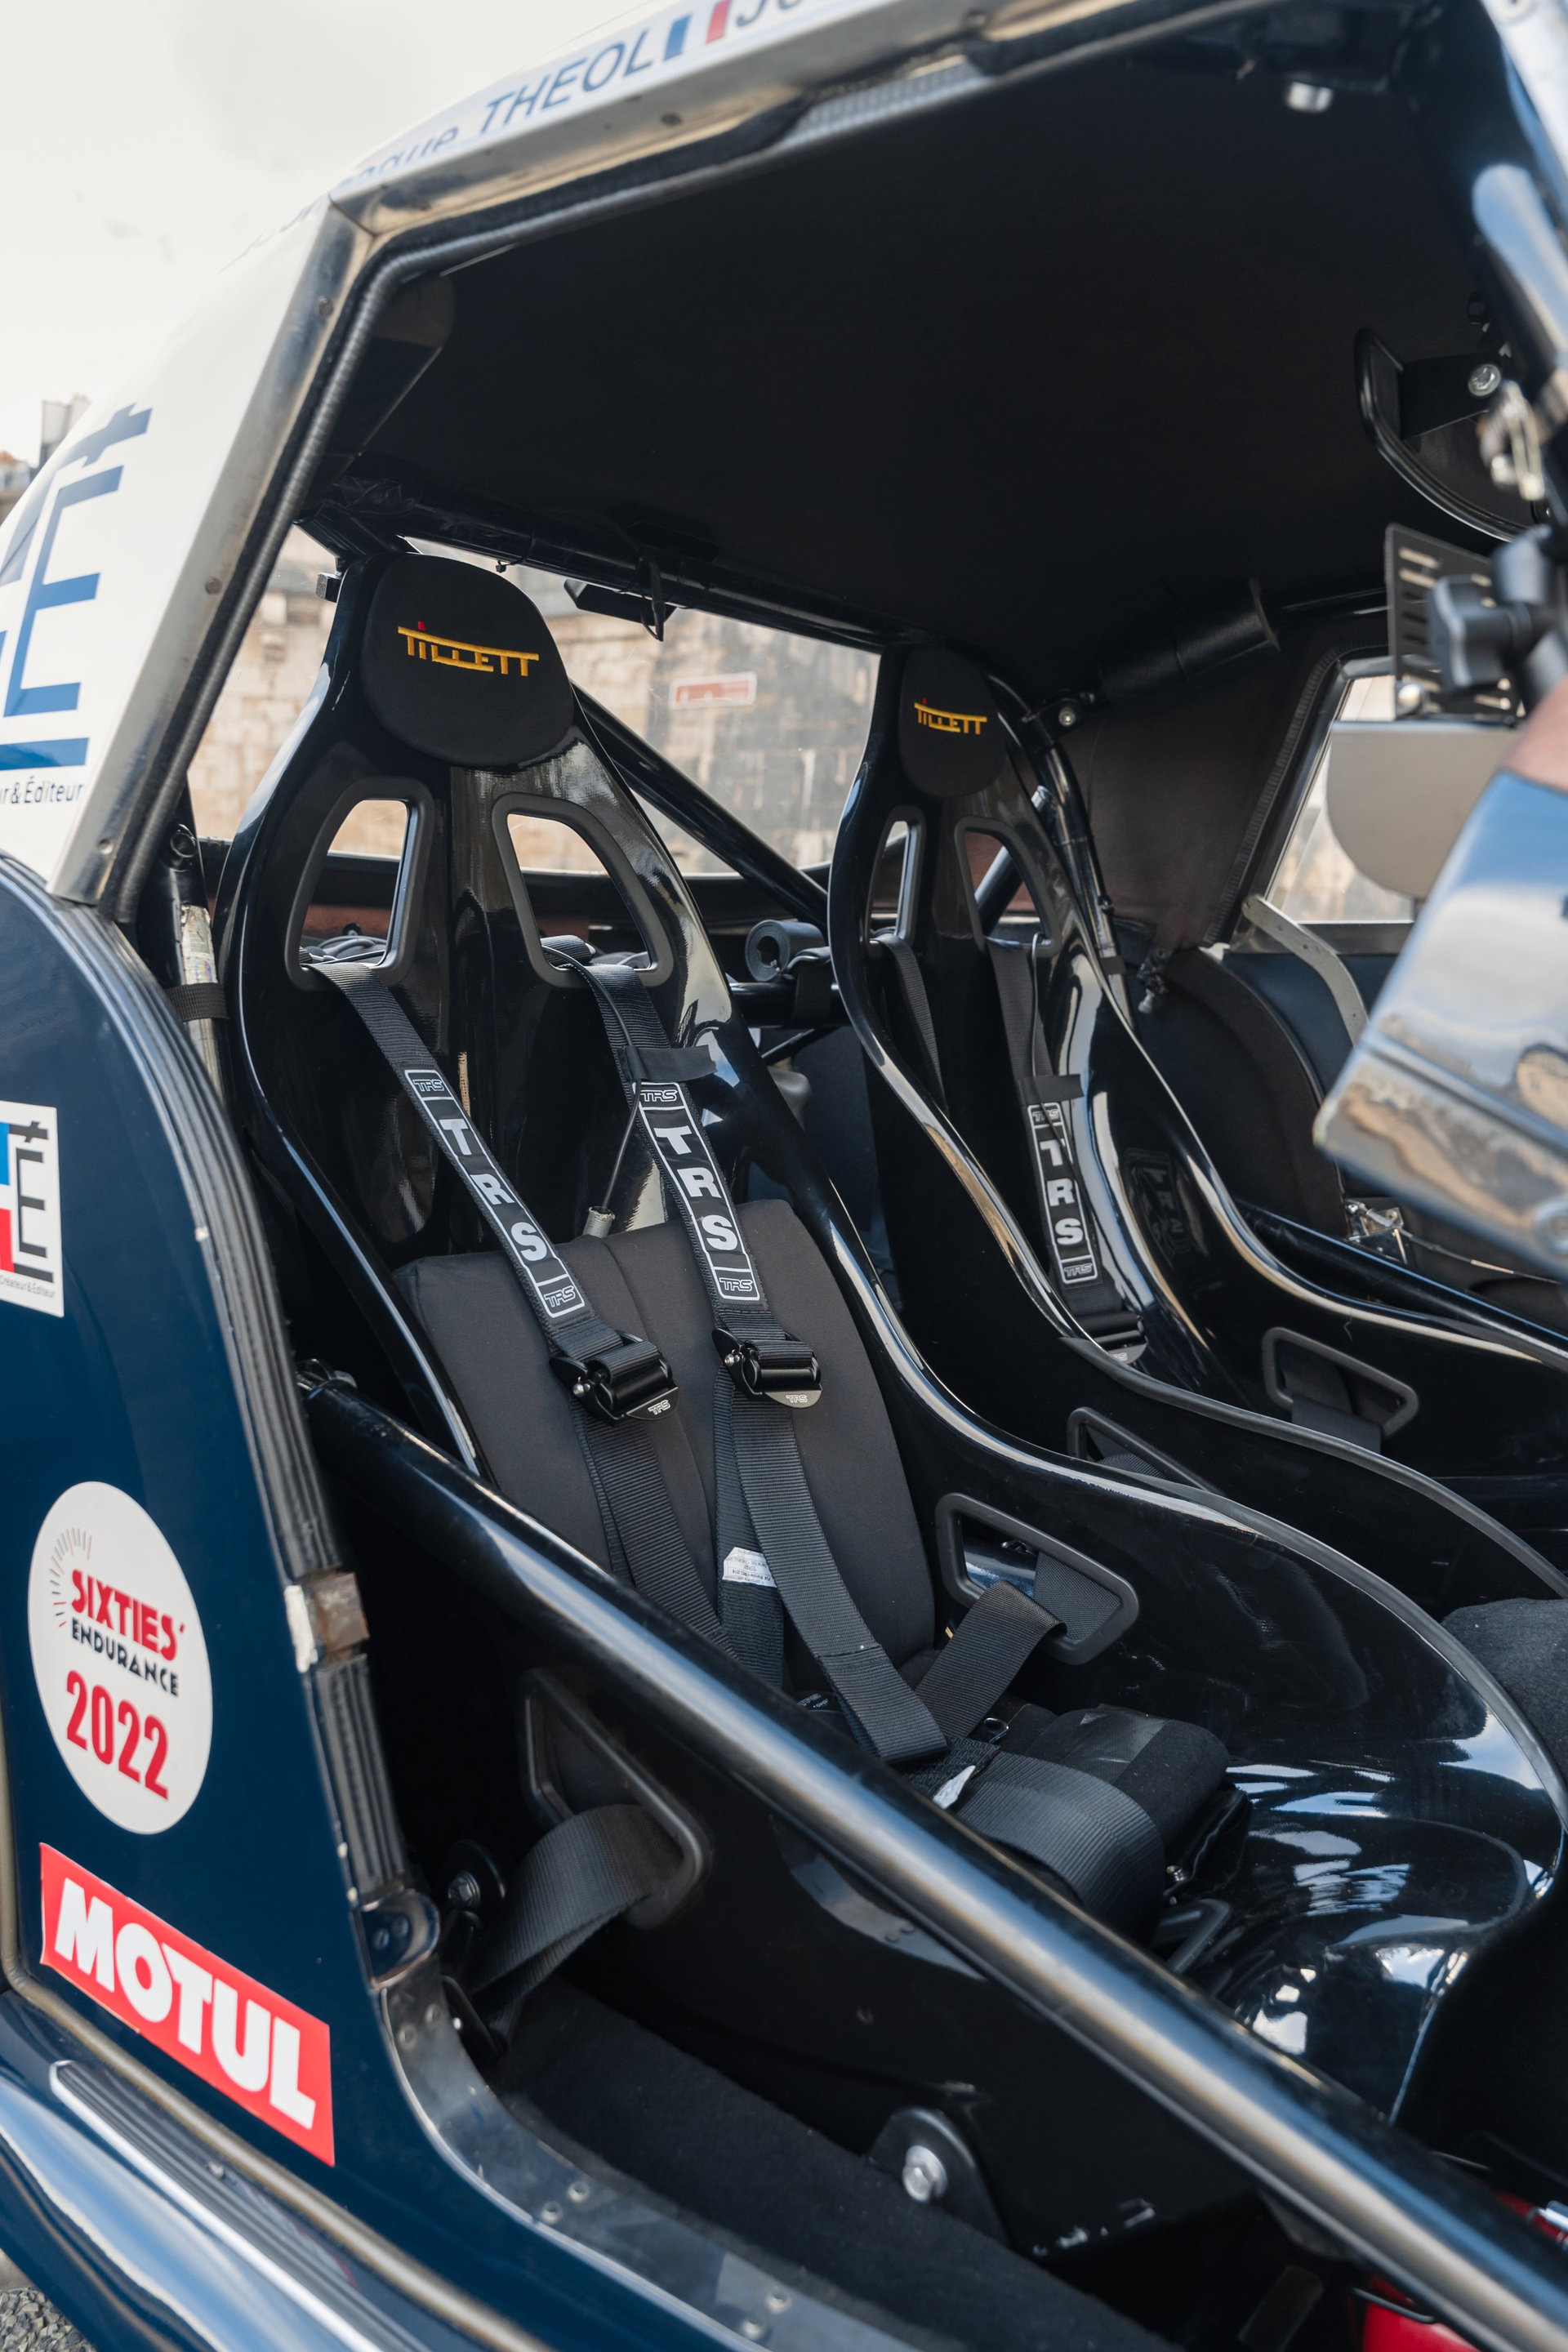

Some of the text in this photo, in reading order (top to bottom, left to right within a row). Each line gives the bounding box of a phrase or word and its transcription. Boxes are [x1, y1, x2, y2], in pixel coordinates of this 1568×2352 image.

[479, 29, 654, 136] THEOL
[398, 621, 539, 676] TILLETT
[24, 775, 84, 804] Éditeur
[413, 1079, 445, 1092] TRS
[640, 1089, 678, 1102] TRS
[439, 1118, 548, 1262] TRS
[653, 1125, 738, 1251] TRS
[1040, 1138, 1085, 1245] TRS
[719, 1277, 754, 1291] TRS
[1064, 1263, 1093, 1277] TRS
[543, 1285, 575, 1307] TRS
[648, 1399, 671, 1415] TRS
[786, 1395, 808, 1404] TRS
[71, 1617, 179, 1697] ENDURANCE
[67, 1670, 169, 1801] 2022
[55, 1878, 317, 2131] MOTUL
